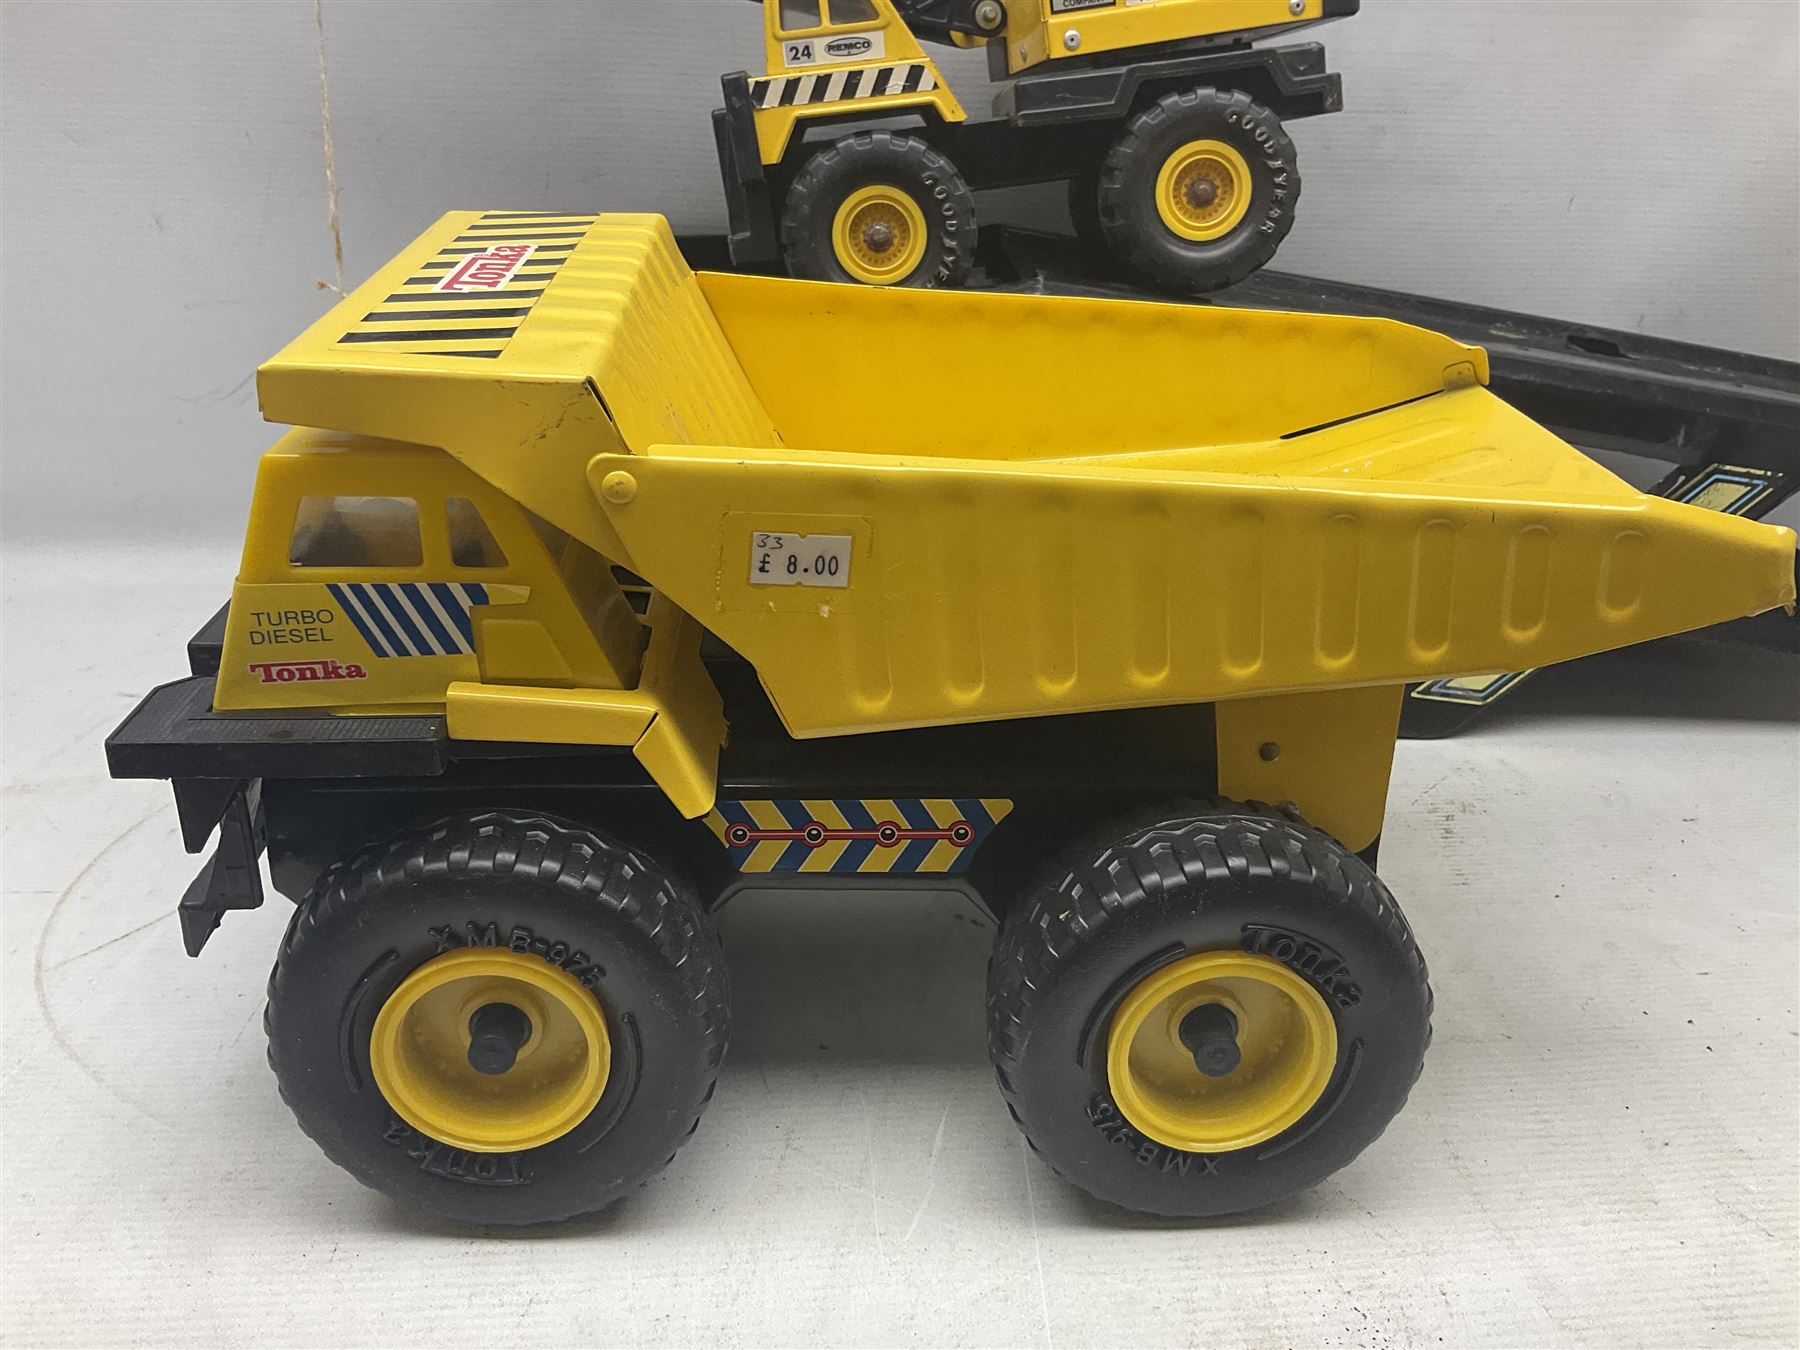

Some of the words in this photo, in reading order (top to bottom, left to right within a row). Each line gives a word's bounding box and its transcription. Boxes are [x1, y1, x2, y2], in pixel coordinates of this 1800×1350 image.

[789, 45, 812, 61] 24
[828, 41, 871, 52] REMCO
[440, 245, 531, 291] Tonka
[757, 534, 783, 549] 33
[758, 553, 770, 573] £
[787, 555, 839, 576] 8.00
[250, 609, 334, 627] TURBO
[249, 627, 333, 645] DIESEL
[249, 660, 367, 683] Tonka
[1241, 923, 1362, 1008] Tonka
